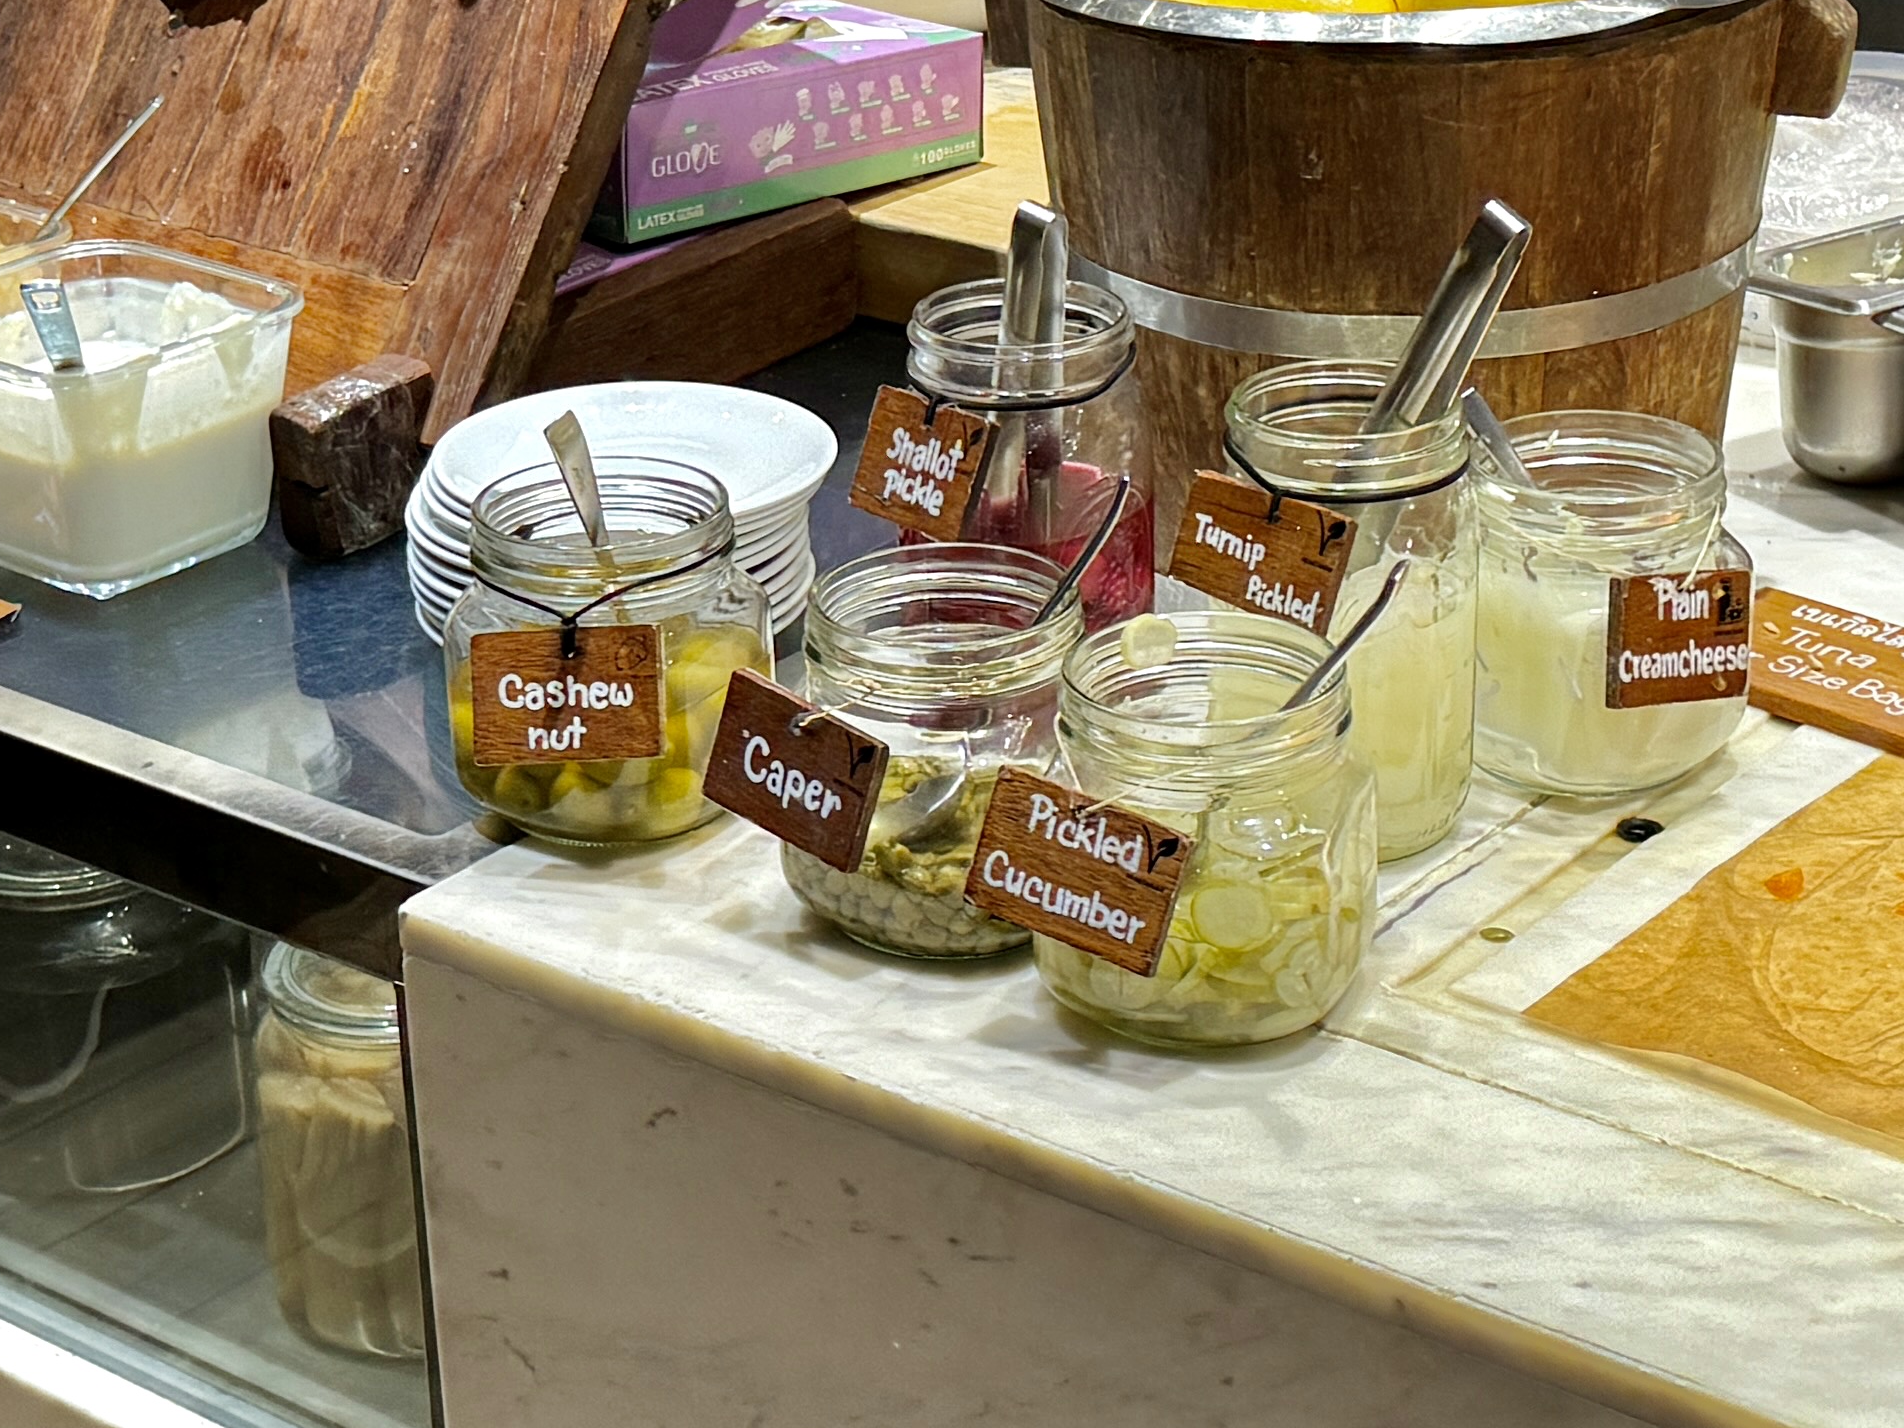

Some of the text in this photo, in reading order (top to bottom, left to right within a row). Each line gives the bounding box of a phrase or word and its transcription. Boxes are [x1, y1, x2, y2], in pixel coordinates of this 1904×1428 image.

[632, 74, 713, 108] ATEX
[638, 210, 676, 230] LATEX
[886, 427, 964, 482] Shallot
[1195, 512, 1266, 571] Turnip
[1246, 574, 1321, 628] Pickled
[1652, 577, 1710, 622] Plain
[1781, 626, 1877, 669] Tuna
[498, 673, 634, 711] Cashew
[1768, 655, 1848, 690] Size
[527, 716, 588, 751] nut
[744, 735, 842, 819] Caper
[1028, 793, 1143, 873] Pickled
[983, 849, 1146, 944] Cucumber
